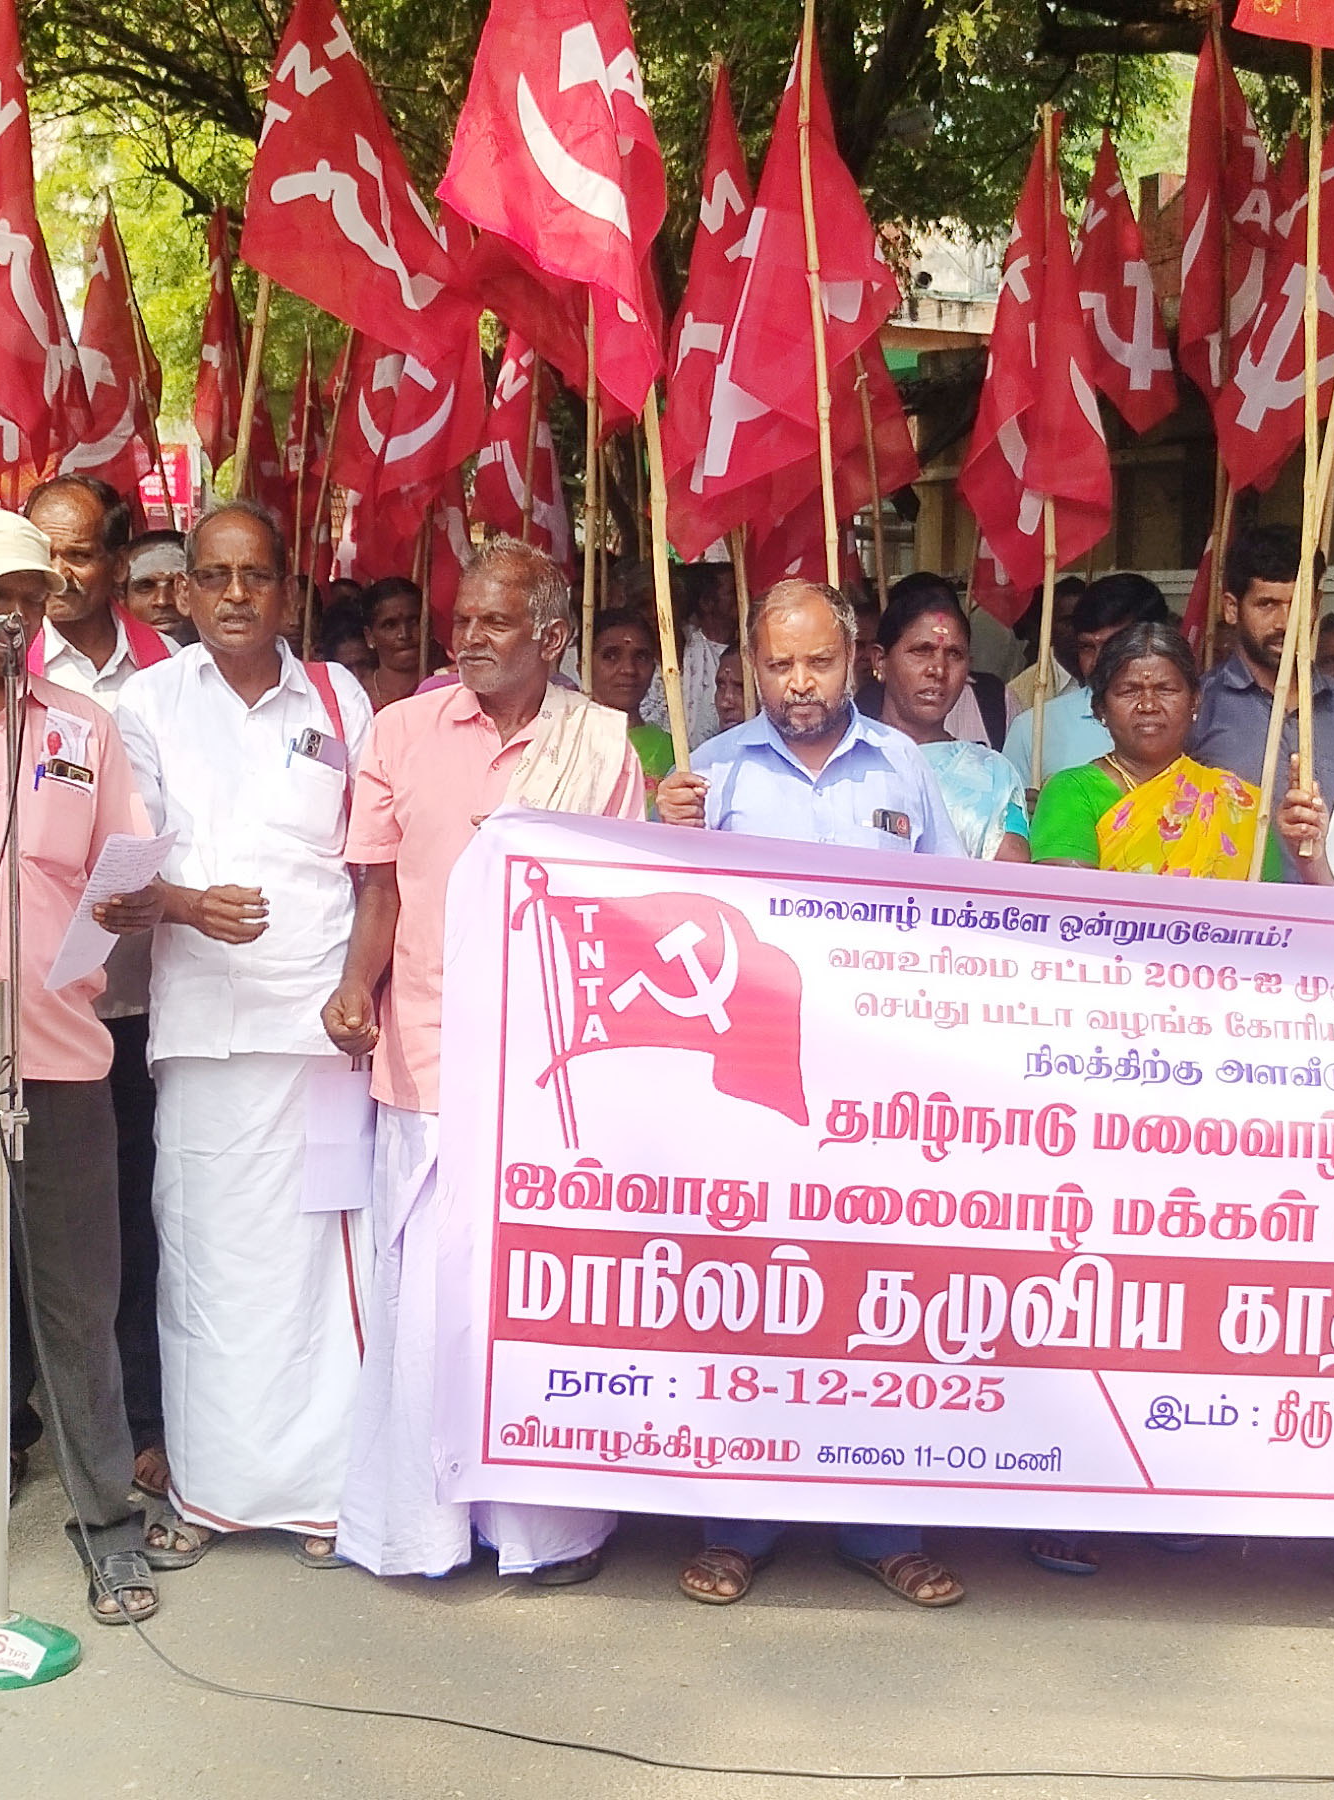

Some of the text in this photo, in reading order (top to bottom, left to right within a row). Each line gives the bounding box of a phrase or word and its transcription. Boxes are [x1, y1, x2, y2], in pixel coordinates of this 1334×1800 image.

[770, 897, 1293, 948] மலைவாழ் மக்களே ஒன்றுபடுவோம்!
[575, 905, 608, 1043] TNTA
[829, 946, 1018, 978] வனஉரிமை
[1031, 950, 1133, 985] சட்டம்
[1146, 962, 1282, 994] 2006-ஐ
[855, 989, 968, 1029] செய்து
[983, 1002, 1072, 1027] பட்டா
[1087, 1005, 1212, 1040] வழங்க
[1024, 1044, 1202, 1086] நிலத்திற்கு
[818, 1091, 1077, 1162] தமிழ்நாடு
[504, 1158, 769, 1232] ஜவ்வாது
[787, 1183, 1095, 1251] மலைவாழ்
[1113, 1187, 1319, 1242] மக்கள்
[508, 1239, 823, 1334] மாநிலம்
[848, 1255, 1185, 1363] தழுவிய
[545, 1365, 653, 1401] நாள்
[697, 1364, 1005, 1412] 18-12-2025
[1145, 1394, 1238, 1431] இடம்
[500, 1416, 1061, 1471] வியாழக்கிழமை காலை 11-00 மணி
